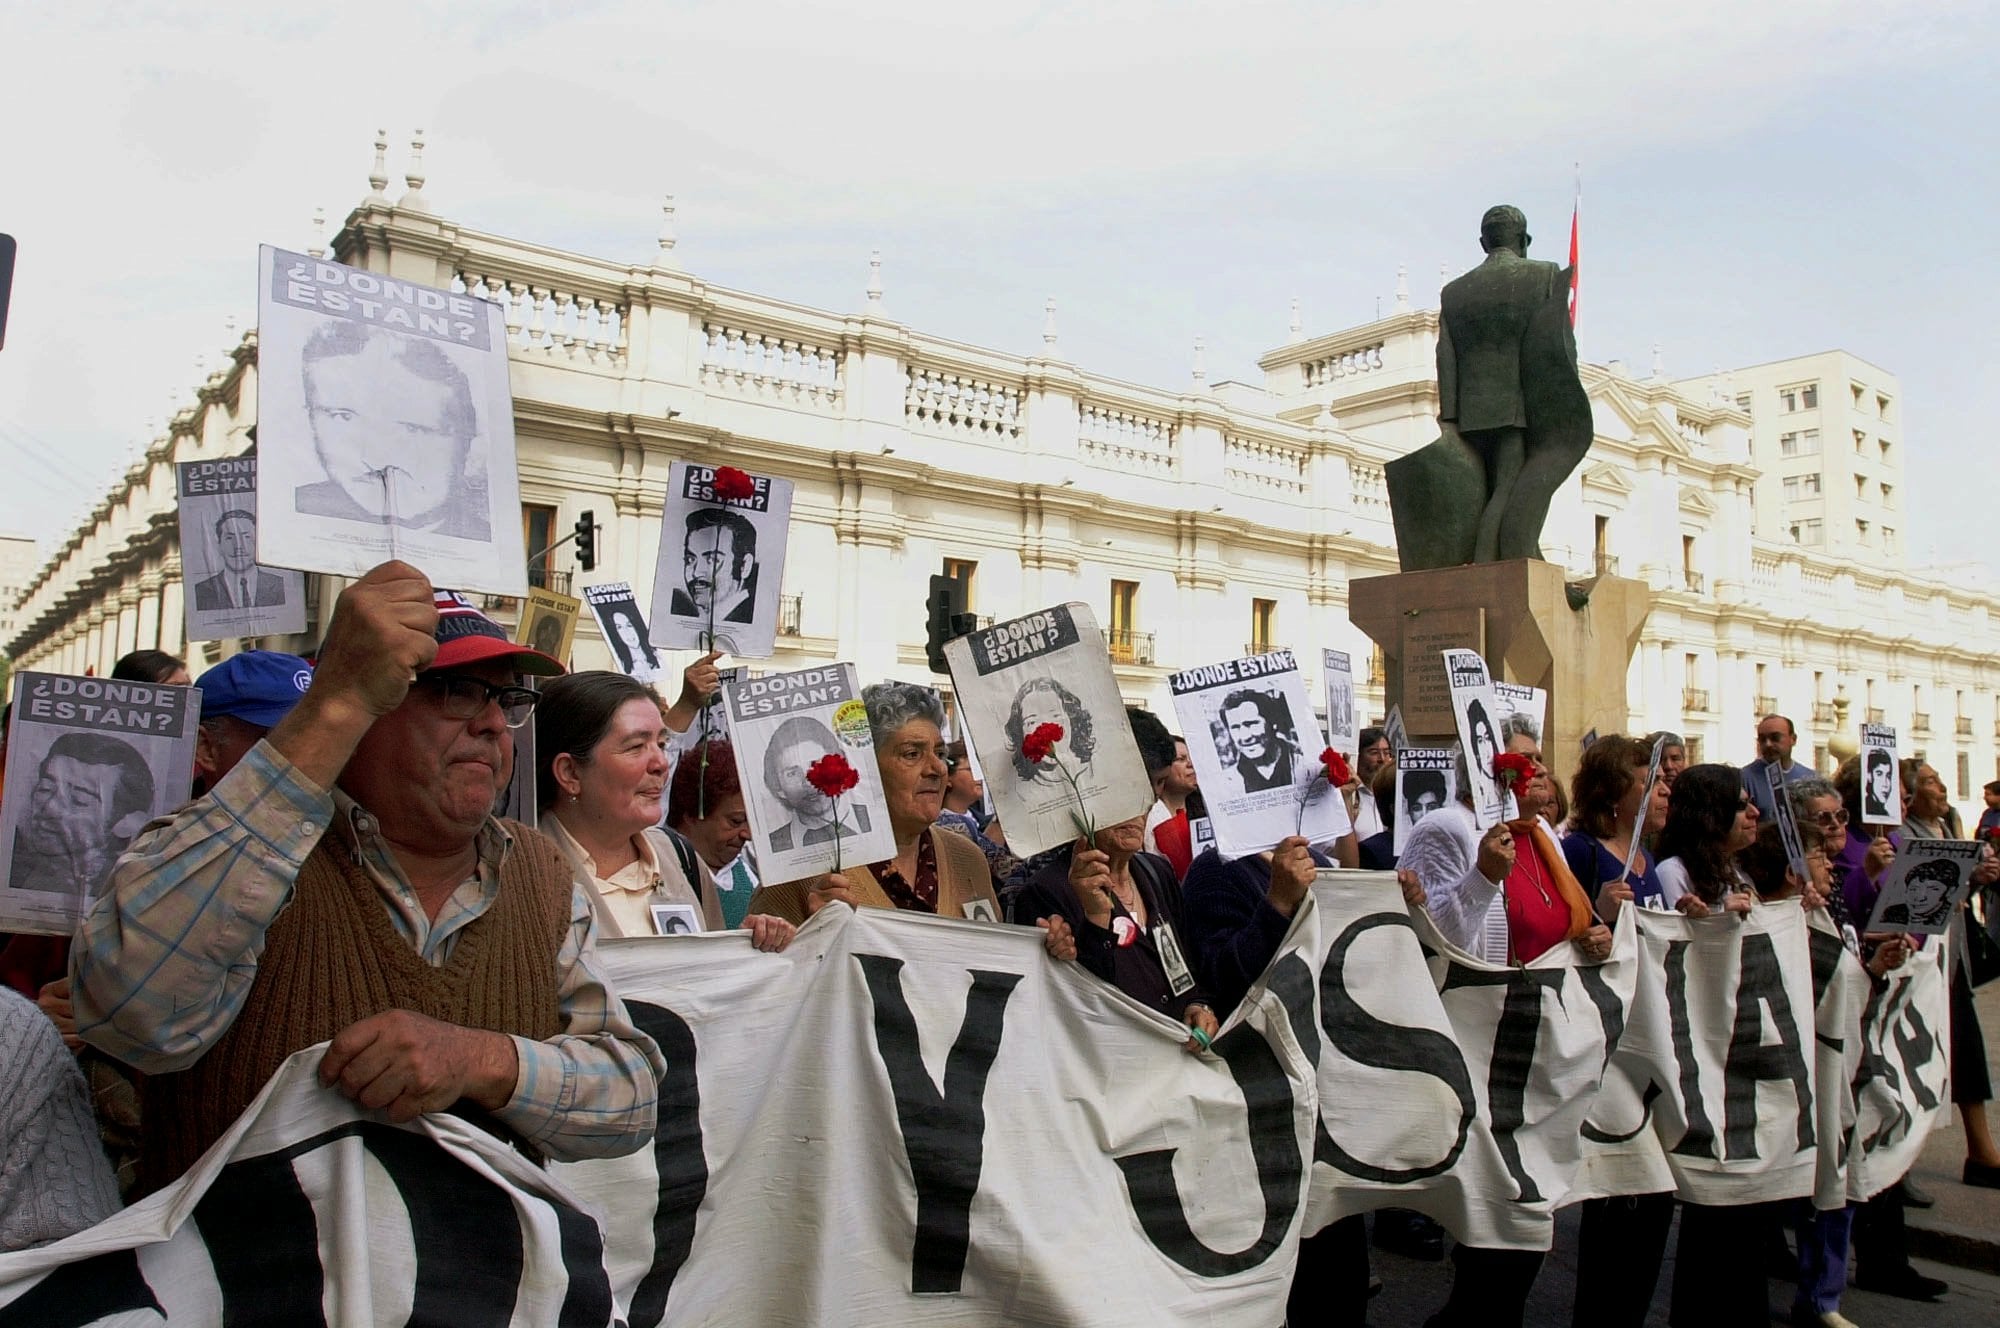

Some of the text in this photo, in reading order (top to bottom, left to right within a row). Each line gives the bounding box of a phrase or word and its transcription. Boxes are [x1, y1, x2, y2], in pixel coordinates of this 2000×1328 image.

[287, 262, 475, 319] ¿DONDE
[287, 281, 476, 341] ESTAN?
[188, 461, 256, 479] ¿DON
[189, 478, 256, 493] ESTA
[689, 468, 767, 493] ¿DE
[688, 483, 765, 509] ESN?
[589, 592, 635, 605] ESTAN?
[983, 610, 1057, 650] ¿DONDE
[737, 668, 840, 701] ¿DONDE
[1175, 651, 1297, 691] ¿DONDE ESTAN?
[1454, 672, 1484, 687] ESTAN?
[33, 677, 176, 708] ¿DONDE
[739, 685, 842, 716] ESTAN?
[31, 699, 173, 731] ESTAN?
[1400, 750, 1455, 759] ¿DONDE
[1400, 760, 1455, 769] ESTAN?
[851, 953, 1024, 1293] Y
